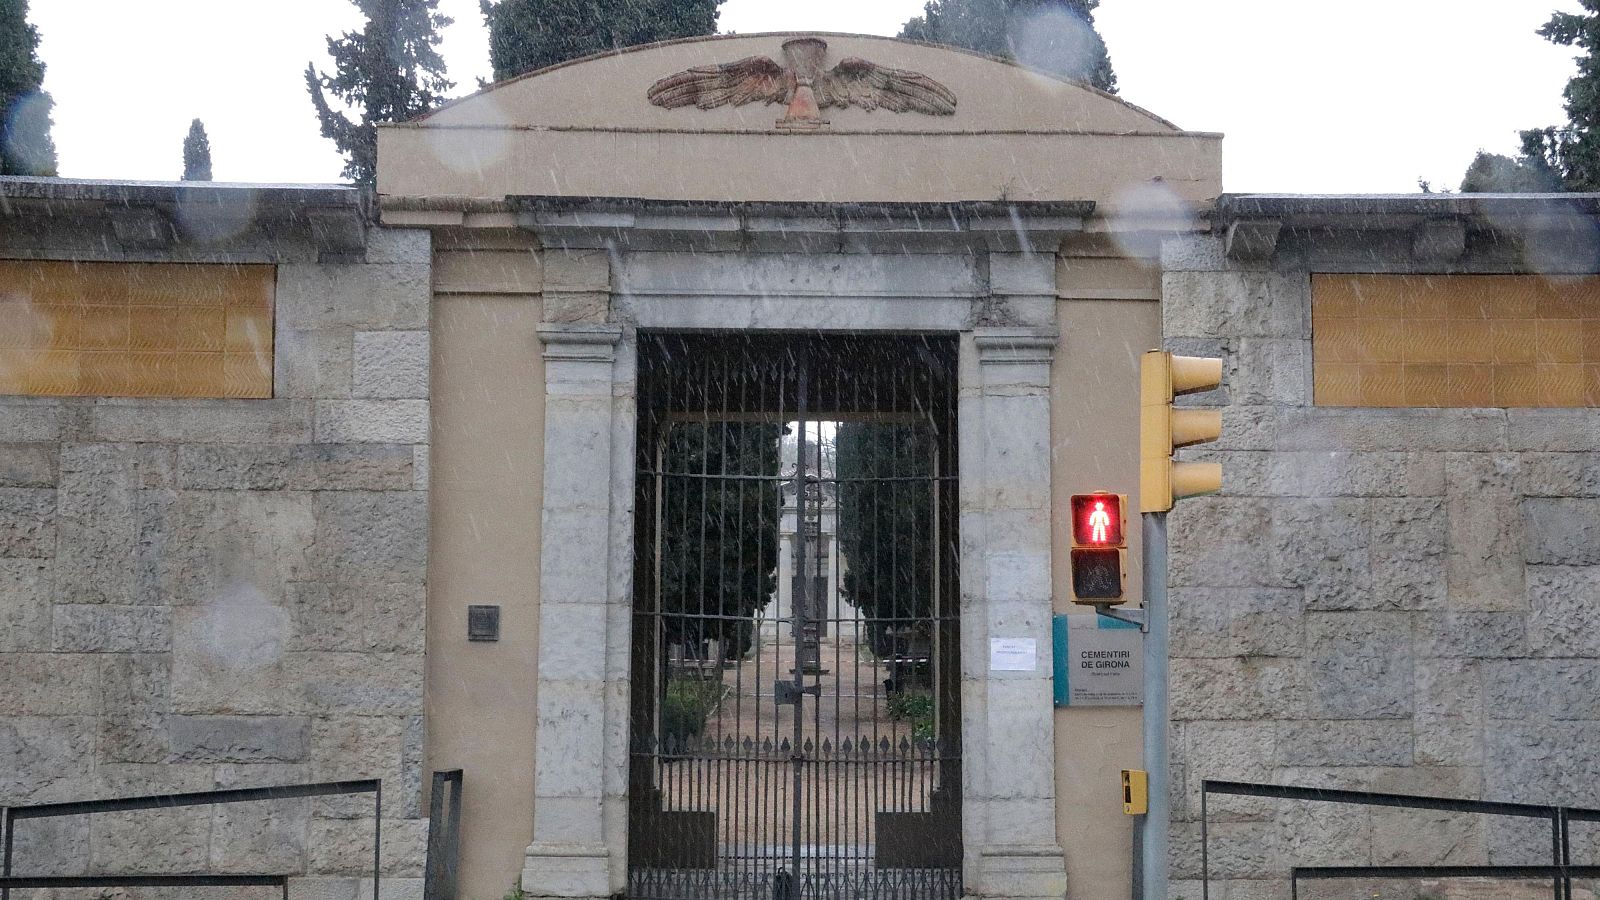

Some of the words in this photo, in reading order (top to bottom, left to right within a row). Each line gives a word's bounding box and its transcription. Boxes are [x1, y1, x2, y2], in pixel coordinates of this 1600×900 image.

[1081, 650, 1130, 659] CEMENTIRI
[1081, 661, 1094, 669] DE
[1095, 660, 1130, 669] GIRONA
